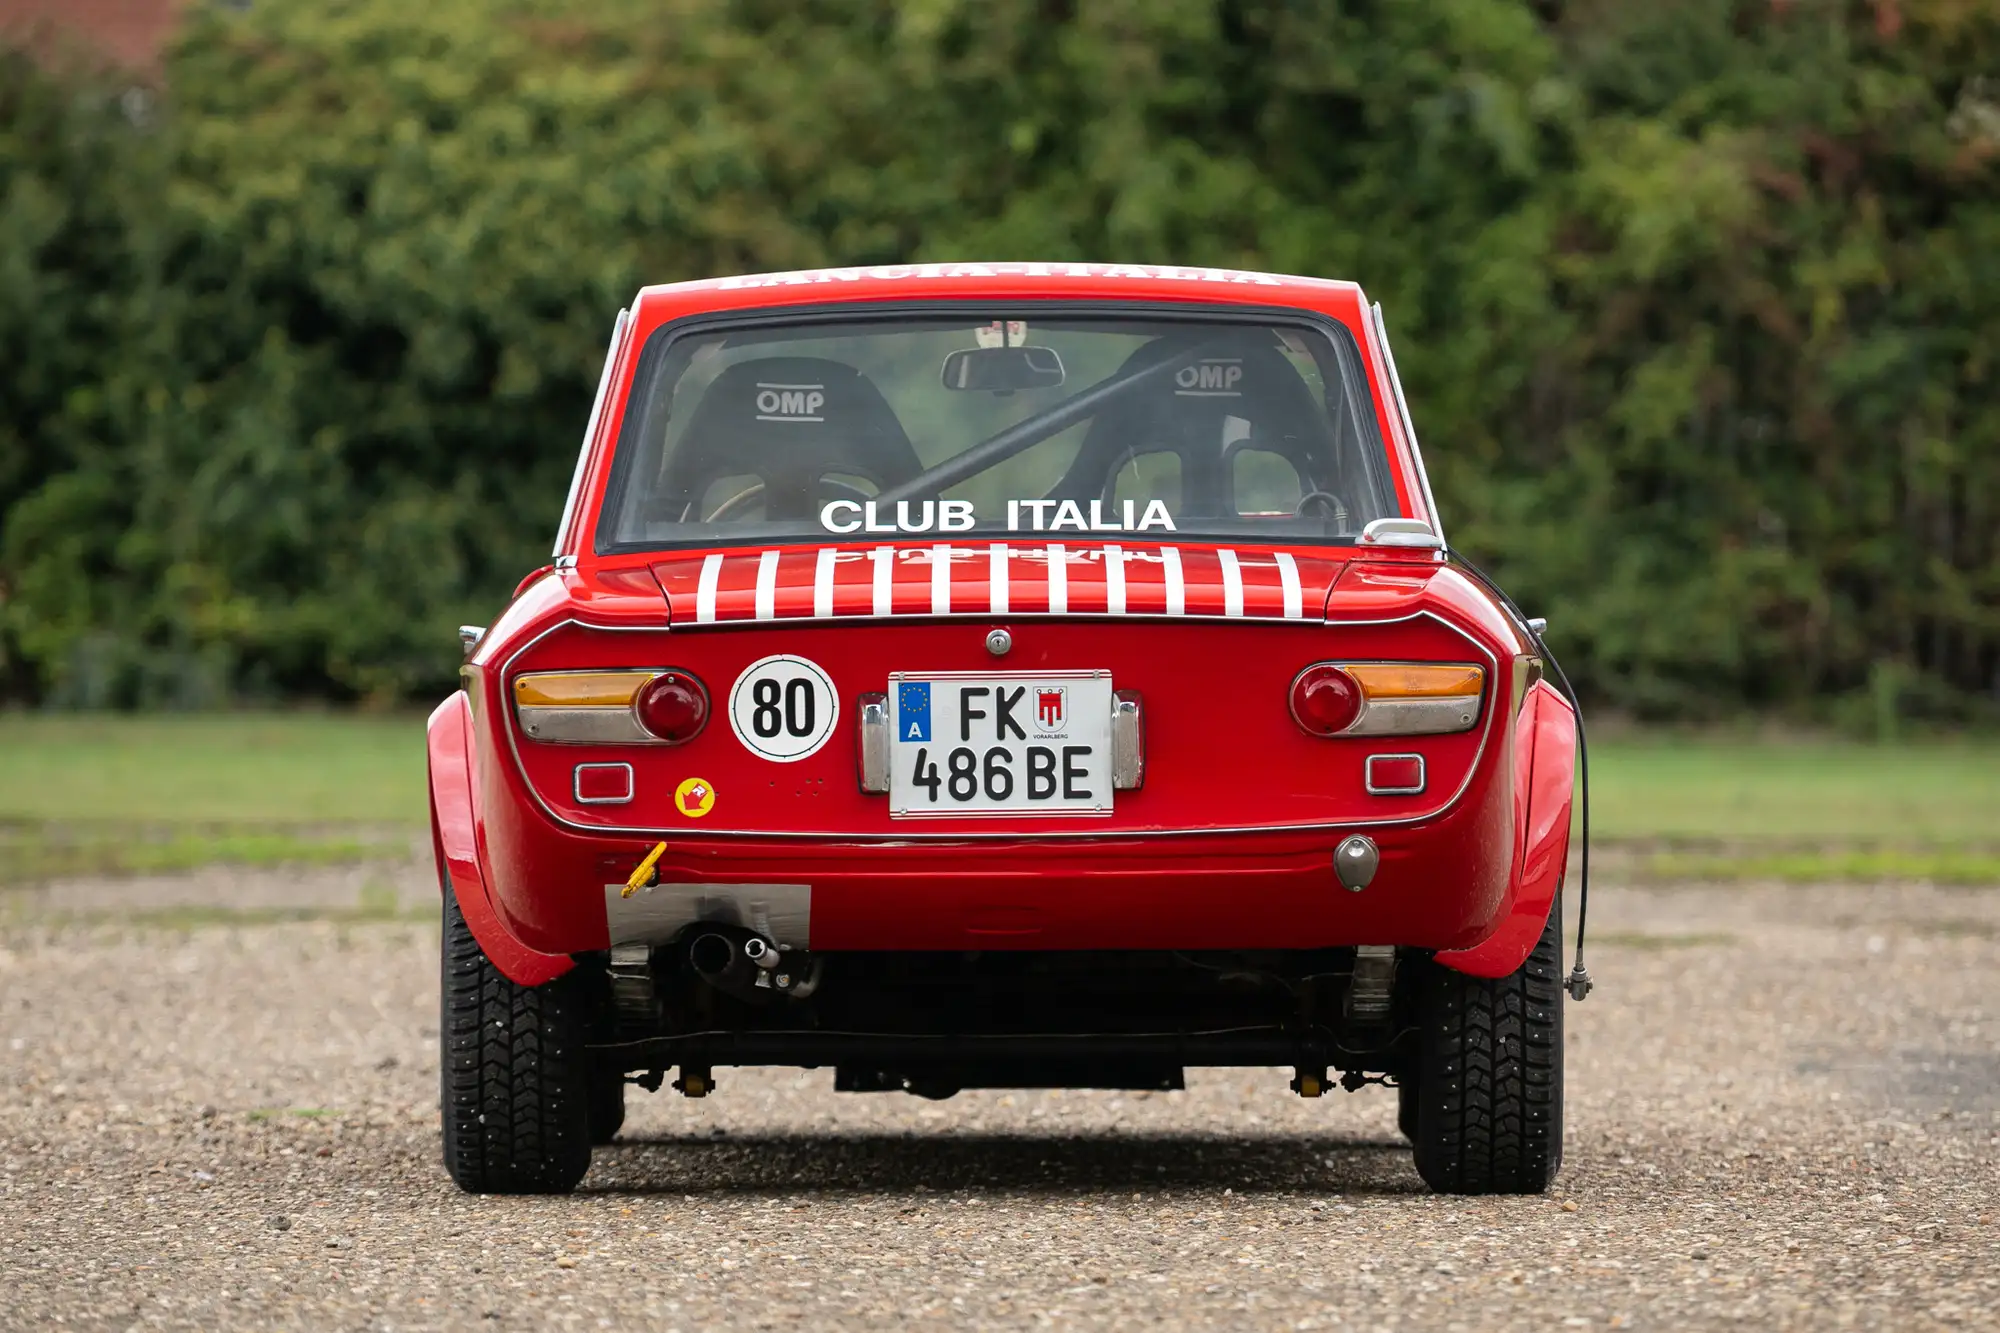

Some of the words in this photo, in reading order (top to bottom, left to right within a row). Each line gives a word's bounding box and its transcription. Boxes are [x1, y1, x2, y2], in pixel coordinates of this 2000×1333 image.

[1175, 366, 1242, 389] OMP
[757, 390, 824, 414] OMP
[820, 500, 976, 532] CLUB
[1007, 500, 1178, 531] ITALIA
[752, 678, 815, 738] 80
[960, 686, 1027, 741] FK
[907, 721, 923, 738] A
